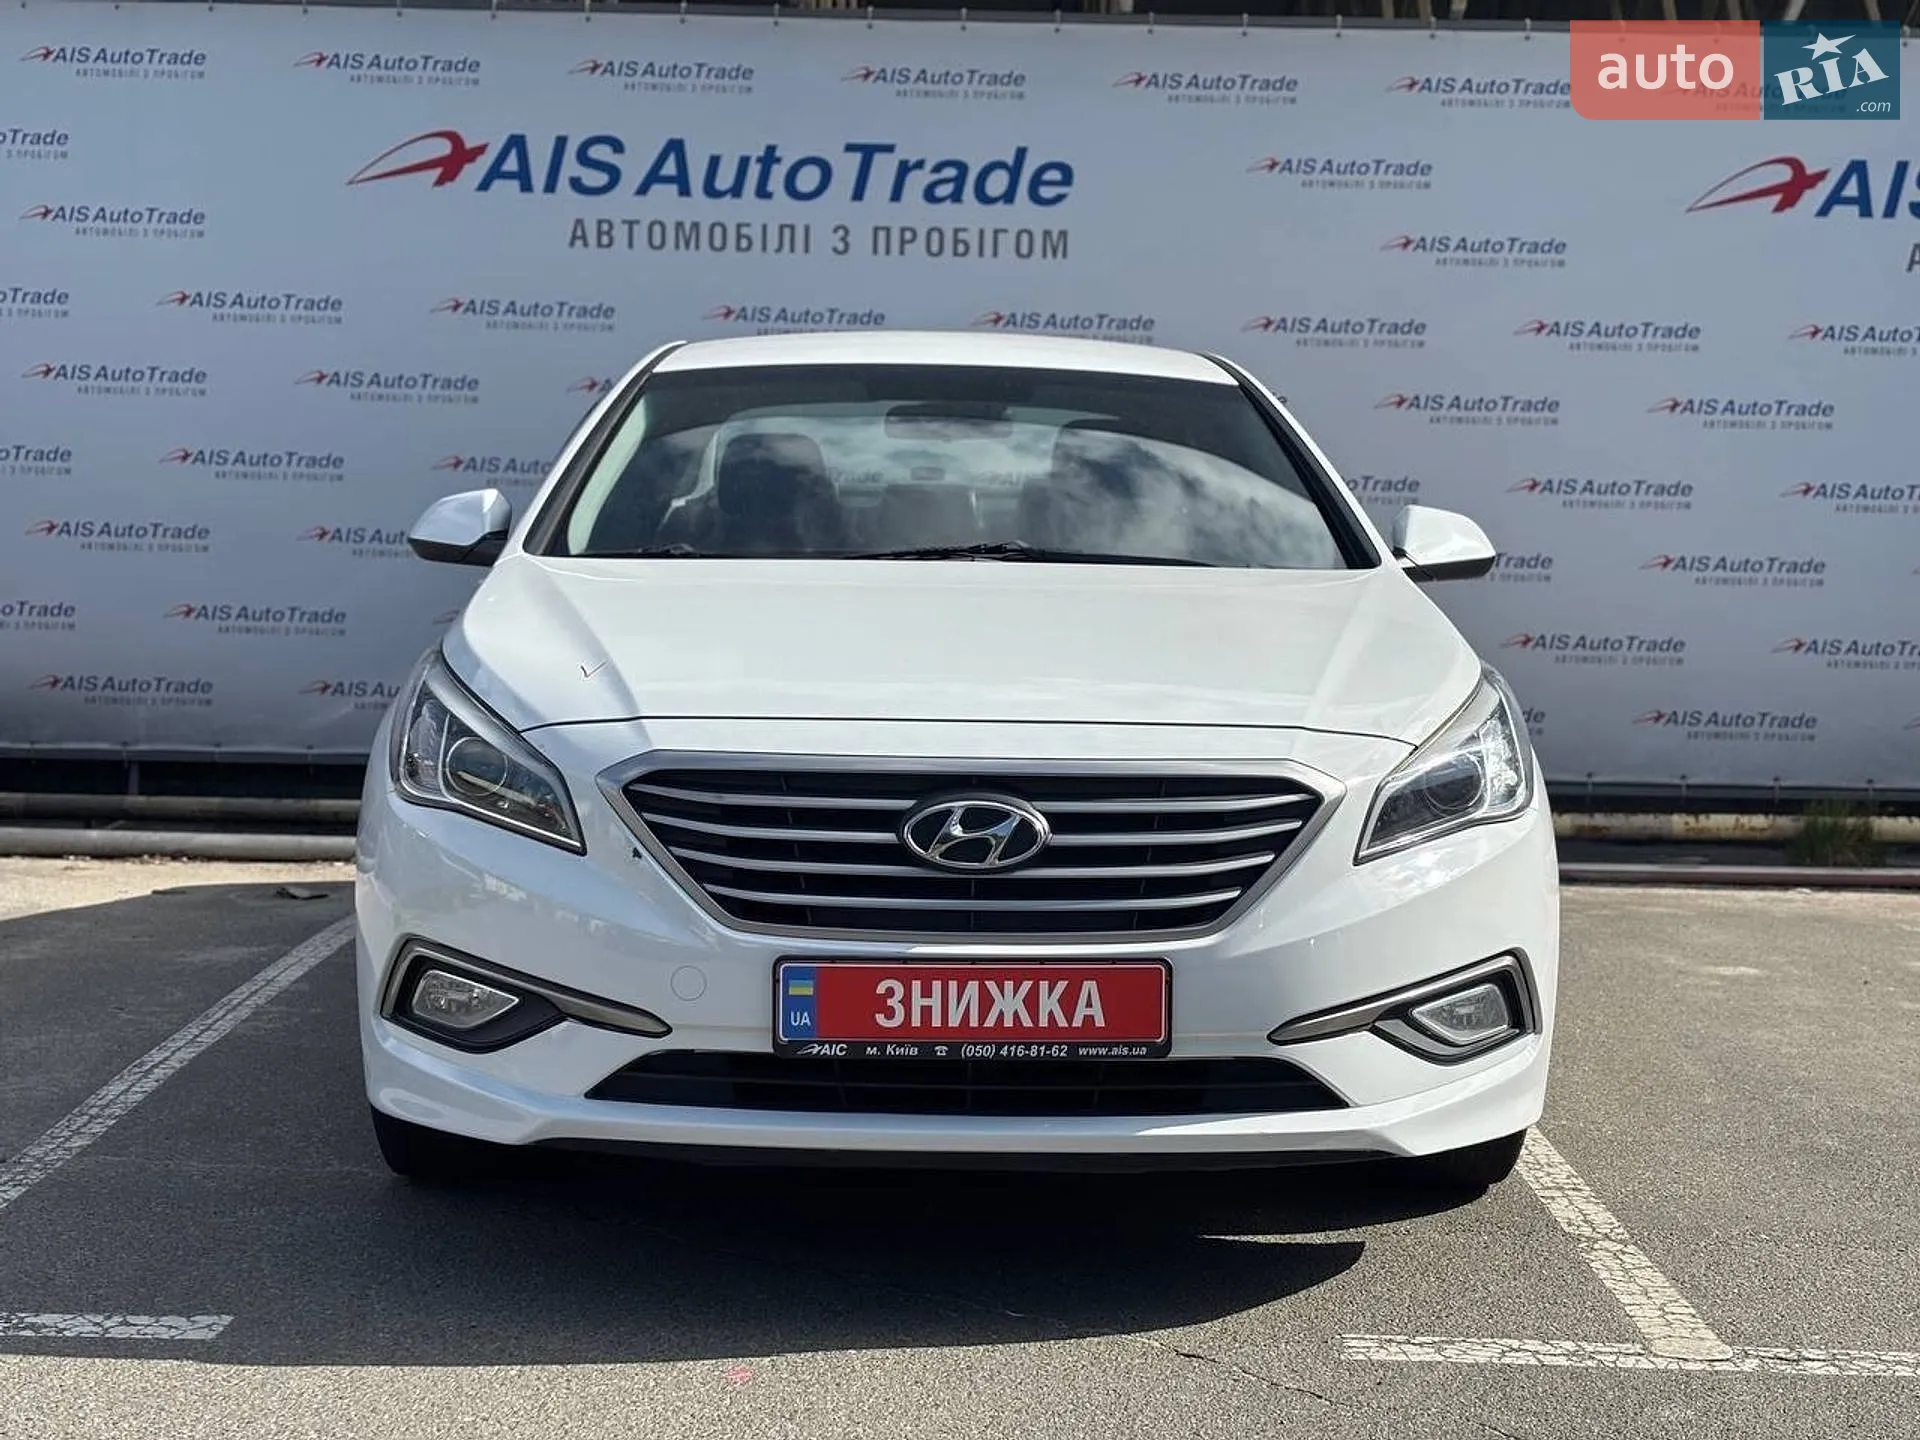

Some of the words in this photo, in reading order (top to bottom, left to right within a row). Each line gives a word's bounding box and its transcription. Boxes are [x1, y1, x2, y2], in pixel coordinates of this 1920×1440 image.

[52, 47, 90, 63] AIS
[325, 53, 364, 69] AIS
[600, 60, 638, 77] AIS
[872, 68, 911, 84] AIS
[1144, 73, 1182, 89] AIS
[1417, 78, 1456, 93] AIS
[475, 134, 625, 197] AIS
[633, 137, 1074, 207] AutoTrade
[1278, 158, 1316, 174] AIS
[1814, 159, 1920, 220] AI
[51, 206, 90, 222] AIS
[569, 218, 811, 255] АВТОМОБІЛІ
[831, 224, 850, 256] З
[872, 225, 1069, 260] ПРОБІГОМ
[1412, 236, 1450, 252] AIS
[188, 292, 227, 308] AIS
[461, 299, 500, 315] AIS
[733, 307, 771, 322] AIS
[1002, 313, 1040, 328] AIS
[1273, 317, 1311, 333] AIS
[1546, 321, 1584, 337] AIS
[1821, 325, 1859, 341] AIS
[52, 364, 91, 380] AIS
[325, 371, 364, 387] AIS
[1406, 395, 1444, 410] AIS
[1680, 399, 1718, 415] AIS
[190, 450, 229, 465] AIS
[462, 457, 501, 473] AIS
[1348, 475, 1420, 493] oTrade
[1539, 479, 1577, 494] AIS
[1813, 483, 1850, 499] AIS
[56, 521, 95, 537] AIS
[329, 527, 368, 543] AIS
[1495, 551, 1553, 568] Trade
[1672, 556, 1710, 571] AIS
[193, 605, 232, 620] AIS
[1532, 634, 1570, 650] AIS
[1804, 640, 1842, 655] AIS
[60, 676, 98, 691] AIS
[330, 681, 369, 697] AIS
[1664, 711, 1702, 726] AIS
[875, 979, 1106, 1028] ЗНИЖКА
[790, 1013, 811, 1027] UA
[886, 1043, 918, 1056] Київ
[961, 1043, 996, 1058] (050)
[1000, 1044, 1068, 1057] 416-81-62
[1078, 1045, 1147, 1056] www.ais.ua
